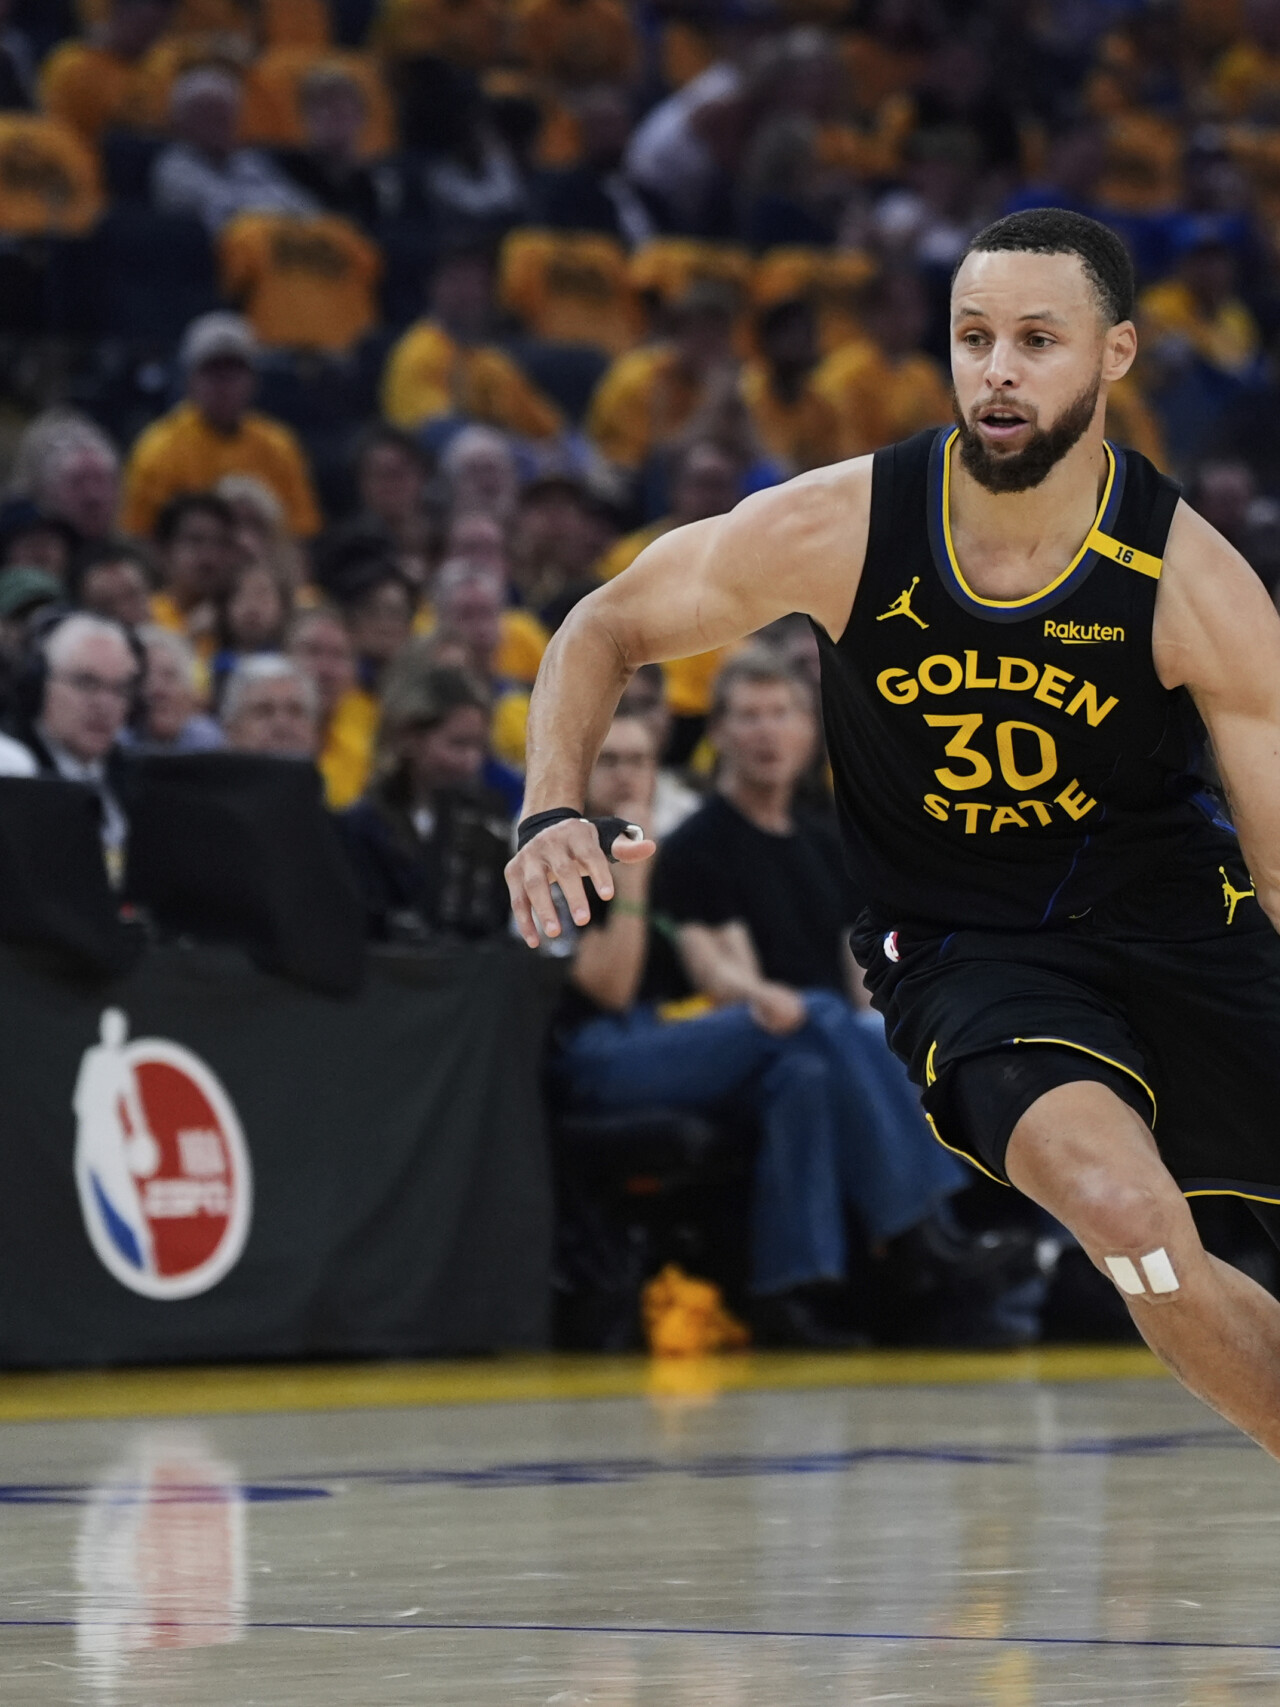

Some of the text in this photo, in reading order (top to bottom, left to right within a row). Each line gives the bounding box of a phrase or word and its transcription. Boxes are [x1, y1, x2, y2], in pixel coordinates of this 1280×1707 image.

[1115, 546, 1134, 564] 16
[1043, 620, 1125, 642] Rakuten
[876, 649, 1120, 728] GOLDEN
[923, 713, 1058, 792] 30
[923, 778, 1097, 834] STATE
